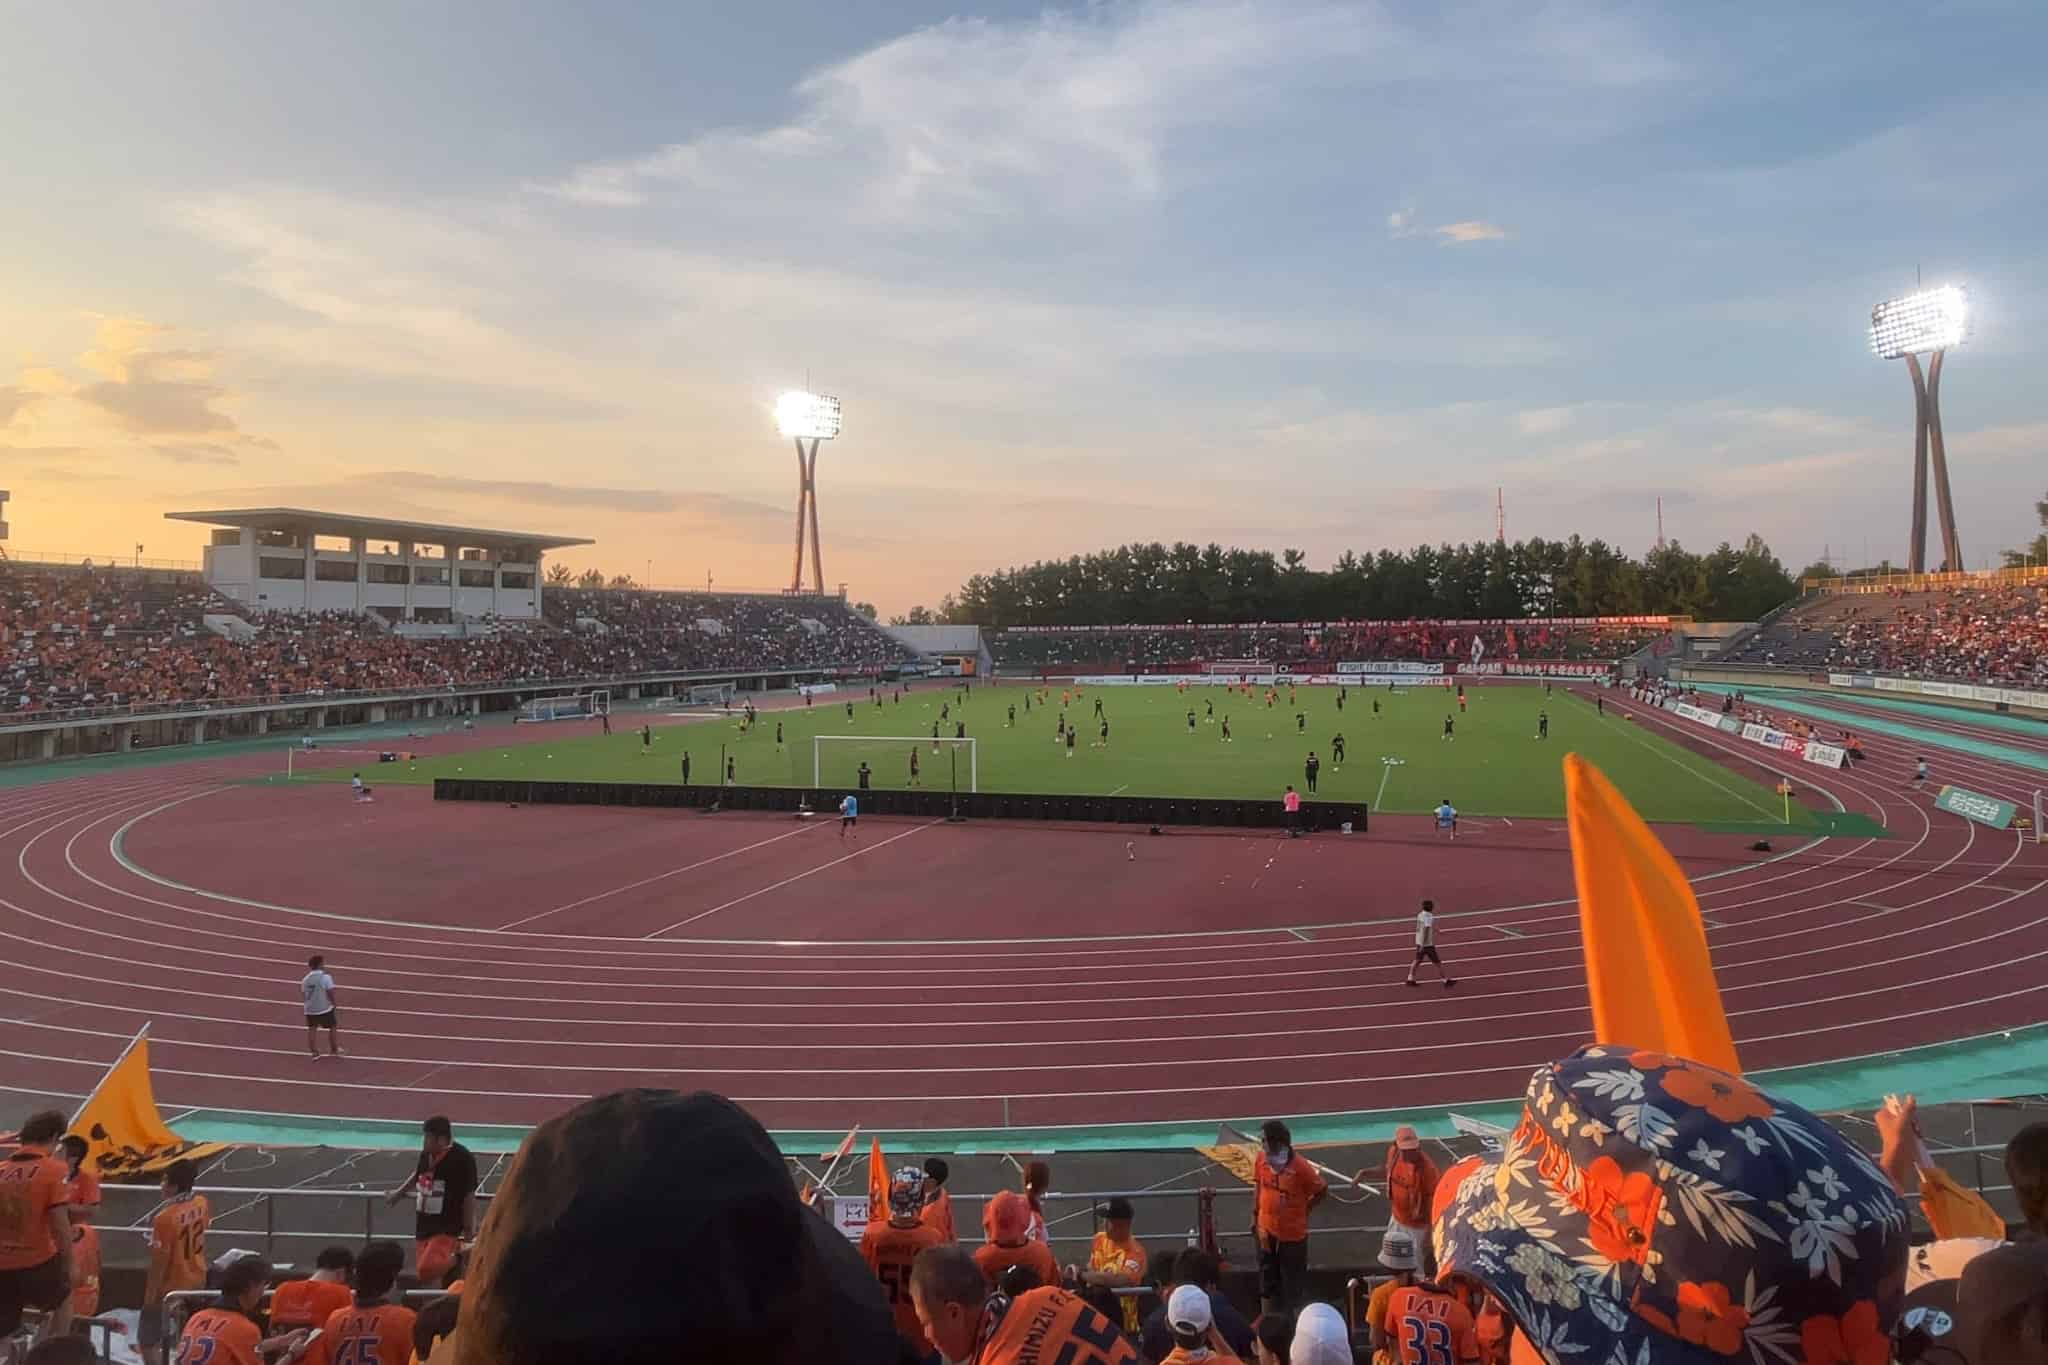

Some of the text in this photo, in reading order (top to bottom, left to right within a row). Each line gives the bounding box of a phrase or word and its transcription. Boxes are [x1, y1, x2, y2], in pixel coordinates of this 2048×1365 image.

[1406, 1294, 1450, 1319] IAI
[339, 1314, 381, 1333] IAI
[1402, 1315, 1454, 1365] 33
